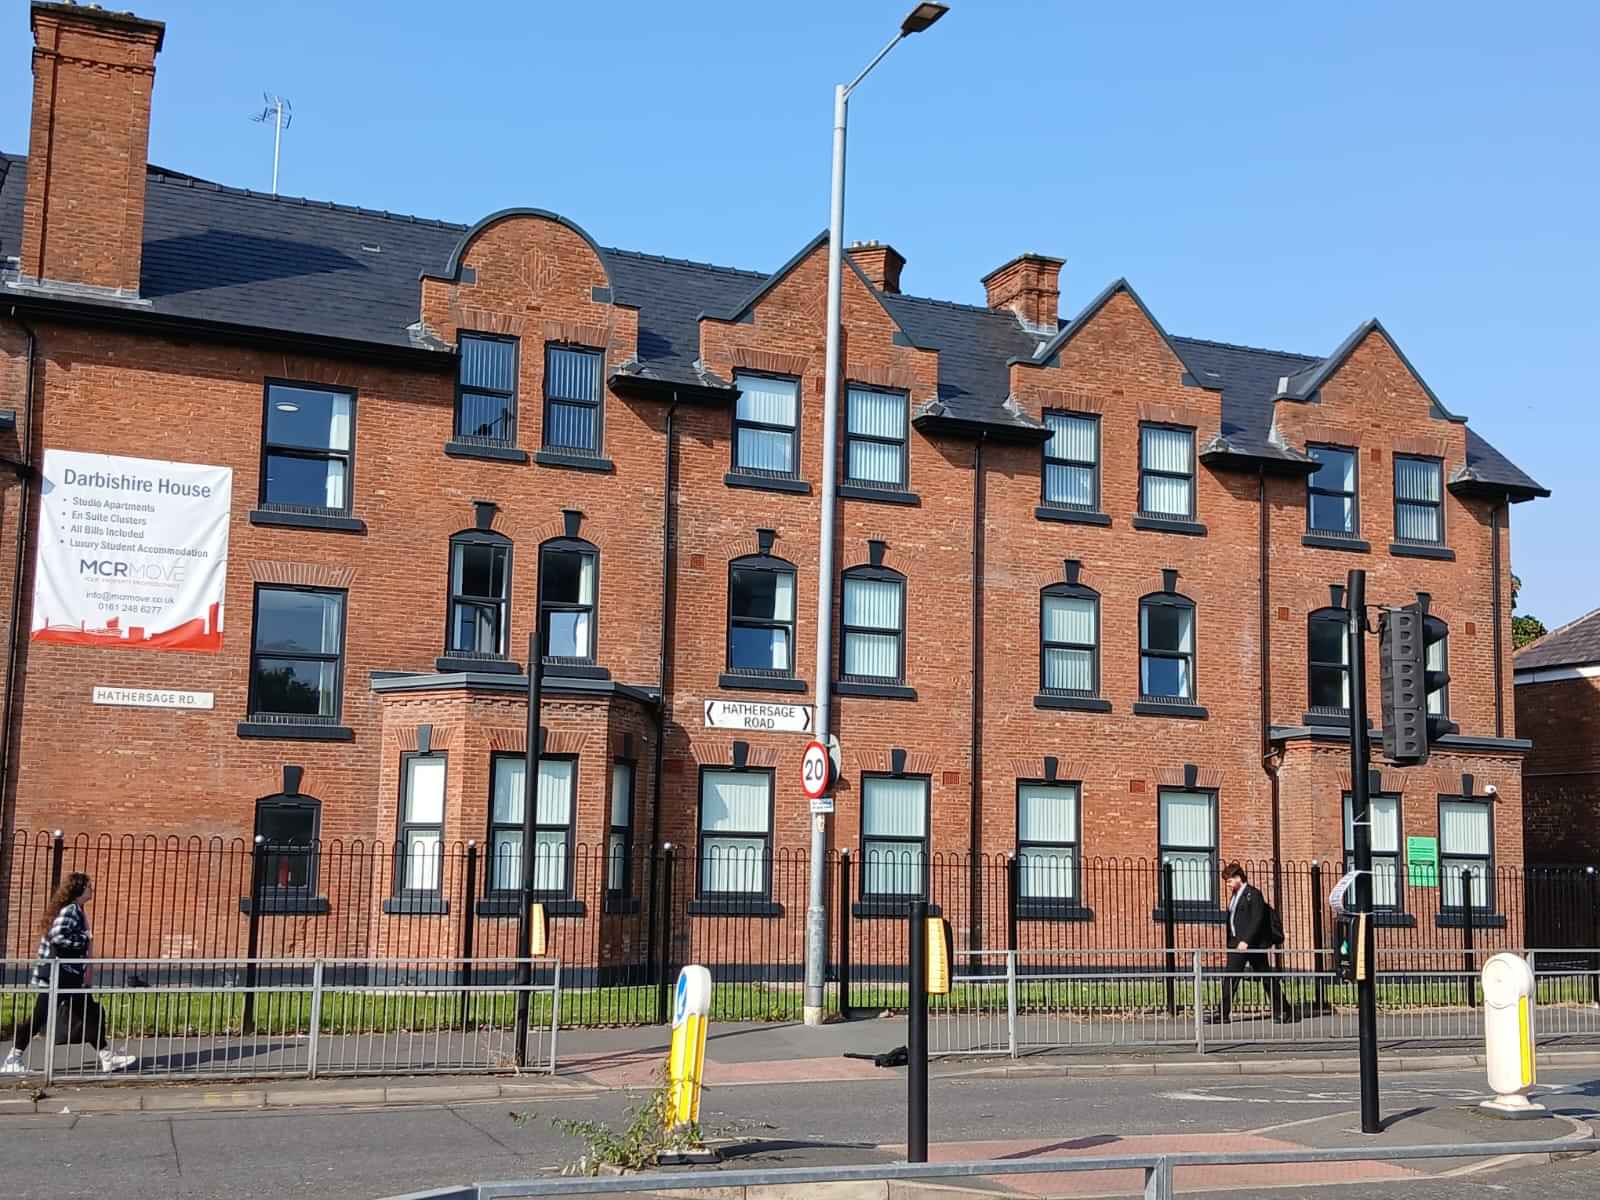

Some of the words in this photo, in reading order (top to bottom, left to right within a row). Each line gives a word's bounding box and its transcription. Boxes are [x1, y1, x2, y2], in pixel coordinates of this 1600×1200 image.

[64, 468, 153, 492] Darbishire
[158, 478, 211, 498] House
[72, 496, 102, 508] Studio
[103, 499, 155, 512] Apartments
[71, 510, 83, 520] En
[85, 511, 109, 523] Suite
[110, 514, 148, 526] Clusters
[70, 524, 83, 534] All
[84, 525, 105, 536] Bills
[106, 527, 145, 539] Included
[69, 538, 100, 551] Luxury
[100, 541, 137, 553] Student
[137, 543, 208, 557] Accommodation
[97, 690, 176, 704] HATHERSAGE
[722, 703, 796, 718] HATHERSAGE
[744, 717, 775, 729] ROAD
[805, 759, 823, 781] 20
